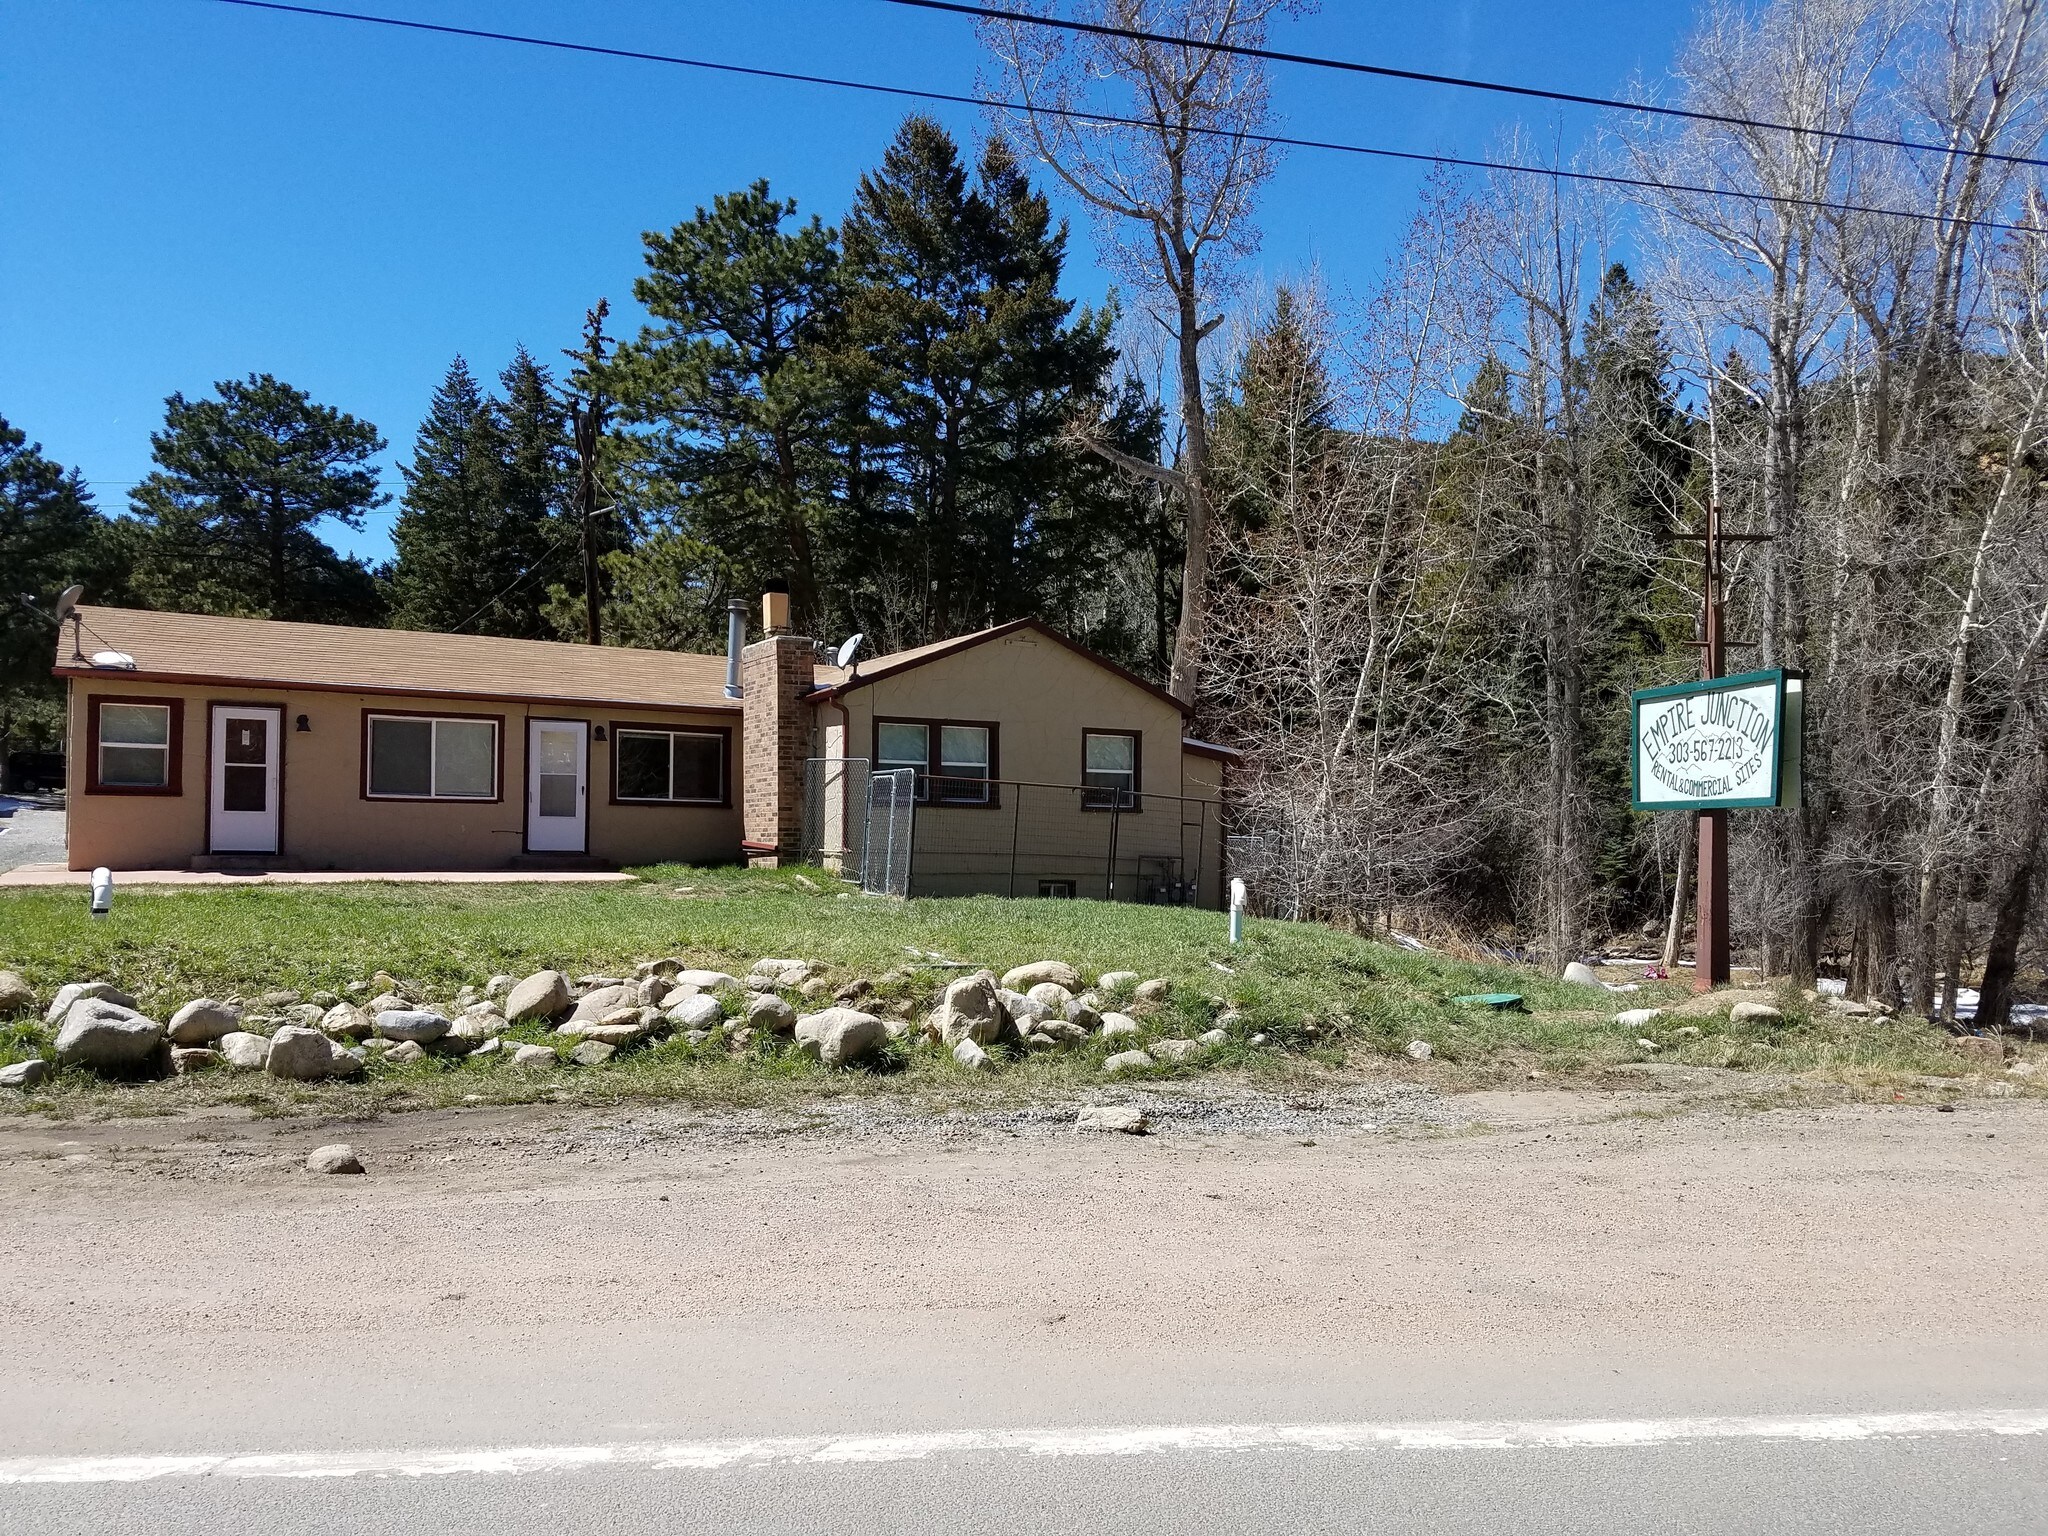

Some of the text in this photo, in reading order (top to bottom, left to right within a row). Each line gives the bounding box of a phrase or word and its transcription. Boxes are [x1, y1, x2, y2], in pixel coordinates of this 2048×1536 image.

[1642, 692, 1774, 762] EMPIRE JUNCTION
[1668, 736, 1743, 764] 303-567-2213
[1735, 753, 1762, 786] SITES
